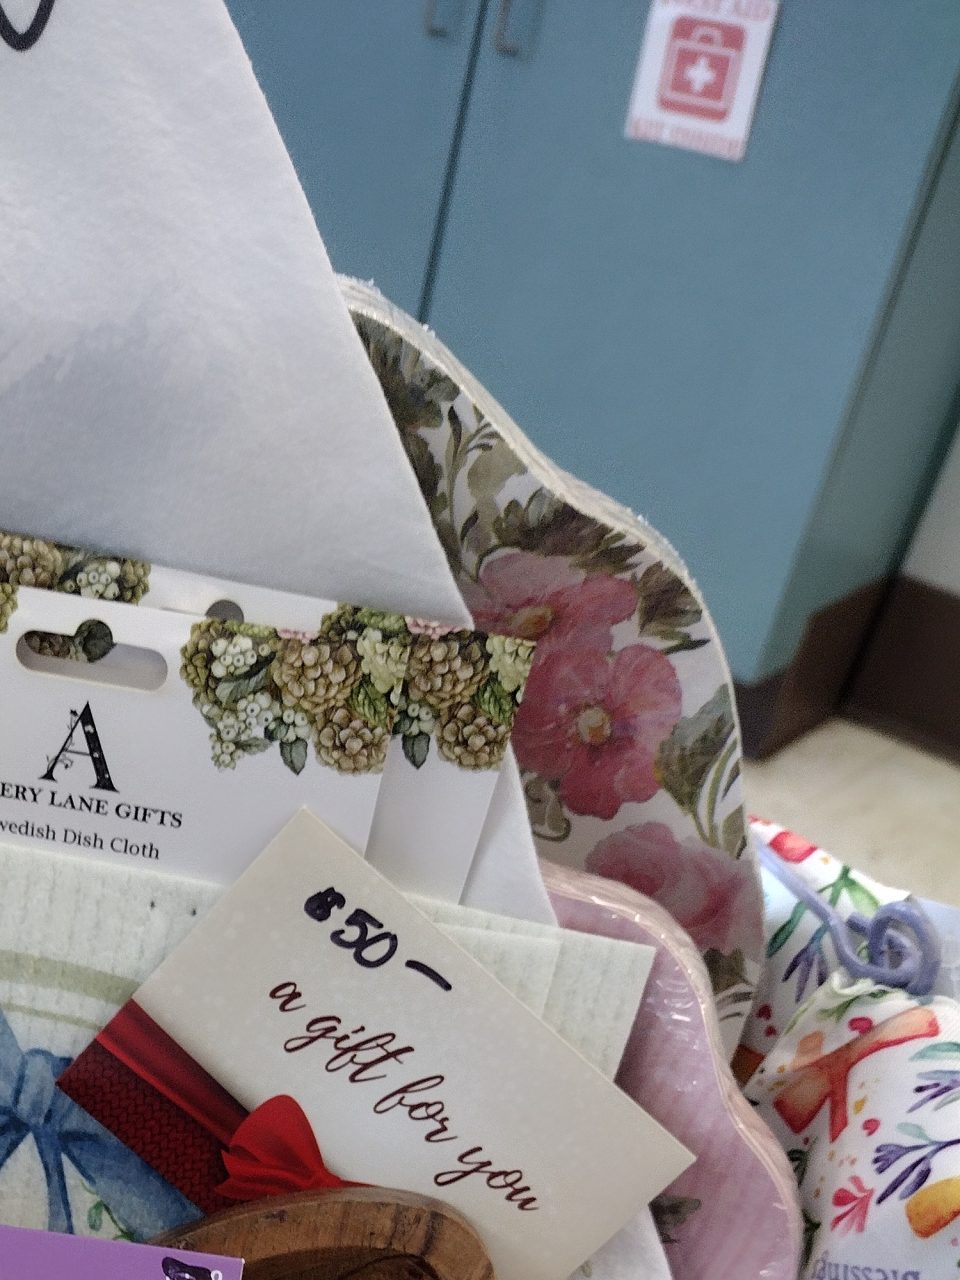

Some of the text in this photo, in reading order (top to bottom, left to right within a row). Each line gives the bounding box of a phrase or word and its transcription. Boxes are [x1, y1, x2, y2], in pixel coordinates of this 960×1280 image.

[49, 791, 109, 816] LANE
[115, 802, 183, 829] GIFTS
[63, 829, 105, 851] Dish
[110, 837, 160, 860] Cloth
[269, 981, 539, 1211] a gift for you
